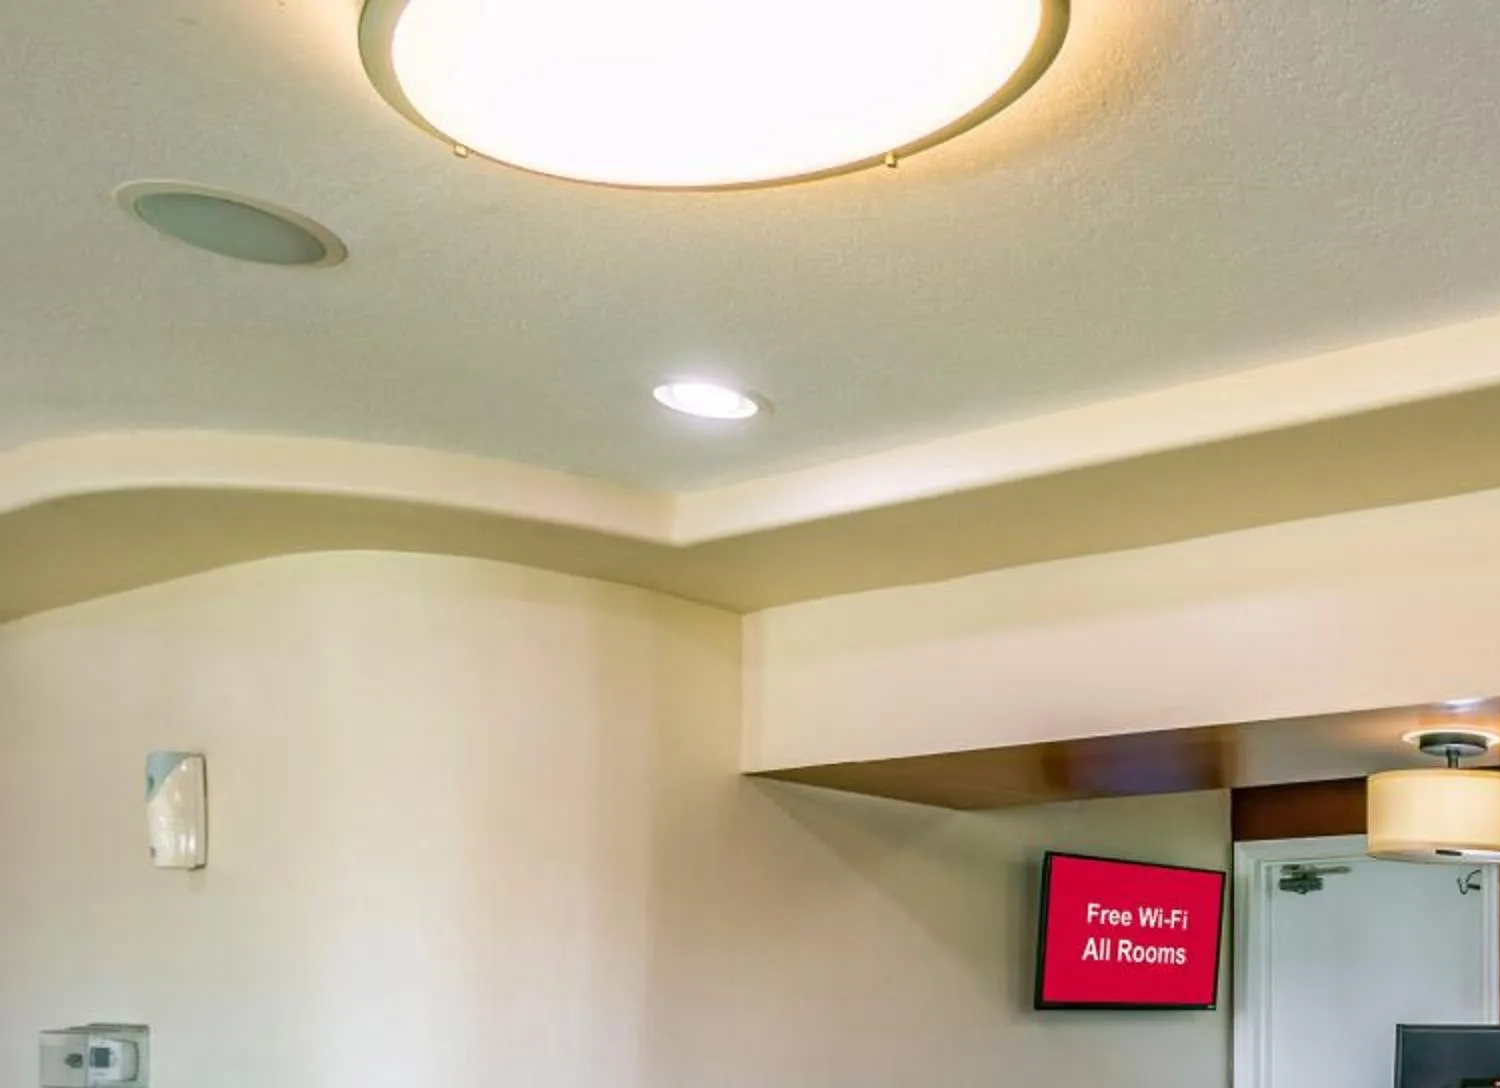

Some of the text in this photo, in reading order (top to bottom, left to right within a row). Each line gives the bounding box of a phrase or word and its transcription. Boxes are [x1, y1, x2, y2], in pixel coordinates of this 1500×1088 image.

[1086, 902, 1188, 930] Free Wi-Fi
[1081, 936, 1187, 965] All Rooms
